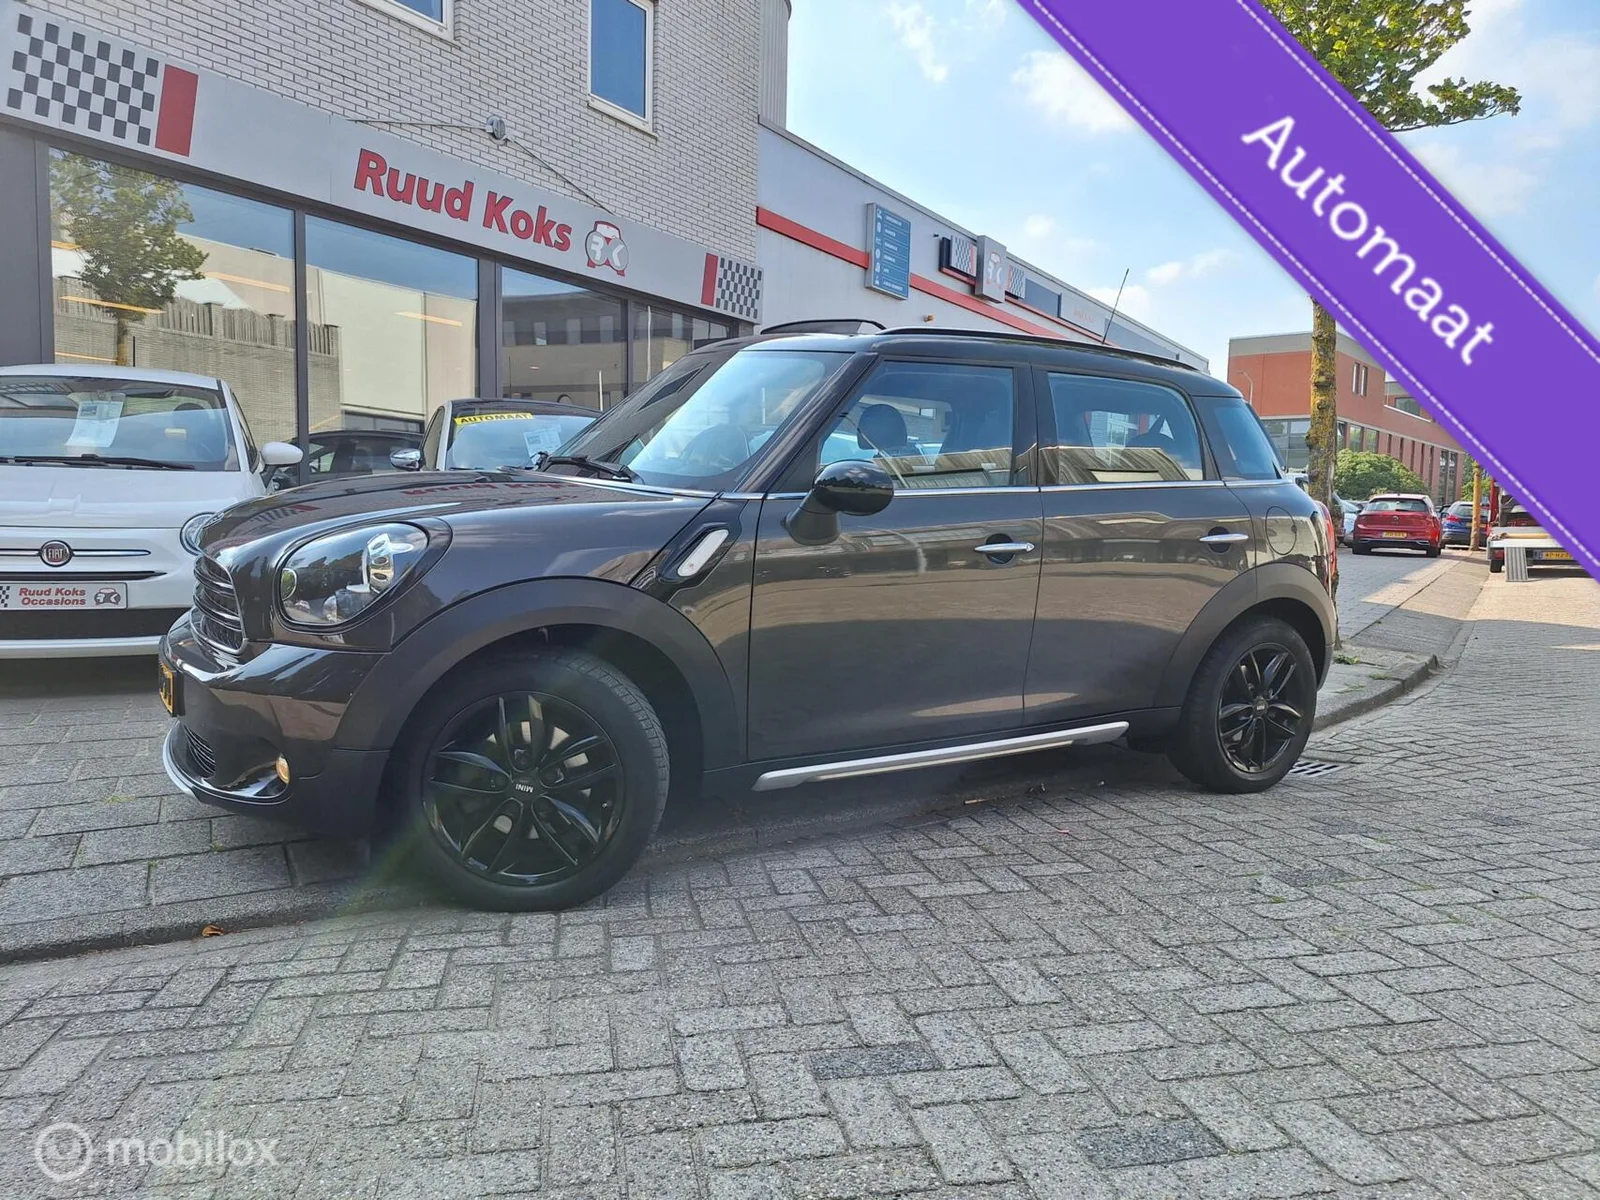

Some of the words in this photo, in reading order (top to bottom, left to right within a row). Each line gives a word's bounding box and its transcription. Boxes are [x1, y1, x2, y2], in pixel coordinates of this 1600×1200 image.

[354, 148, 474, 222] Ruud
[482, 190, 572, 252] Koks
[459, 412, 530, 424] AUTOMAAT
[47, 547, 64, 560] FIAT
[19, 587, 52, 596] Ruud
[54, 587, 86, 597] Koks
[21, 596, 87, 607] Occasions
[515, 783, 534, 793] MINI
